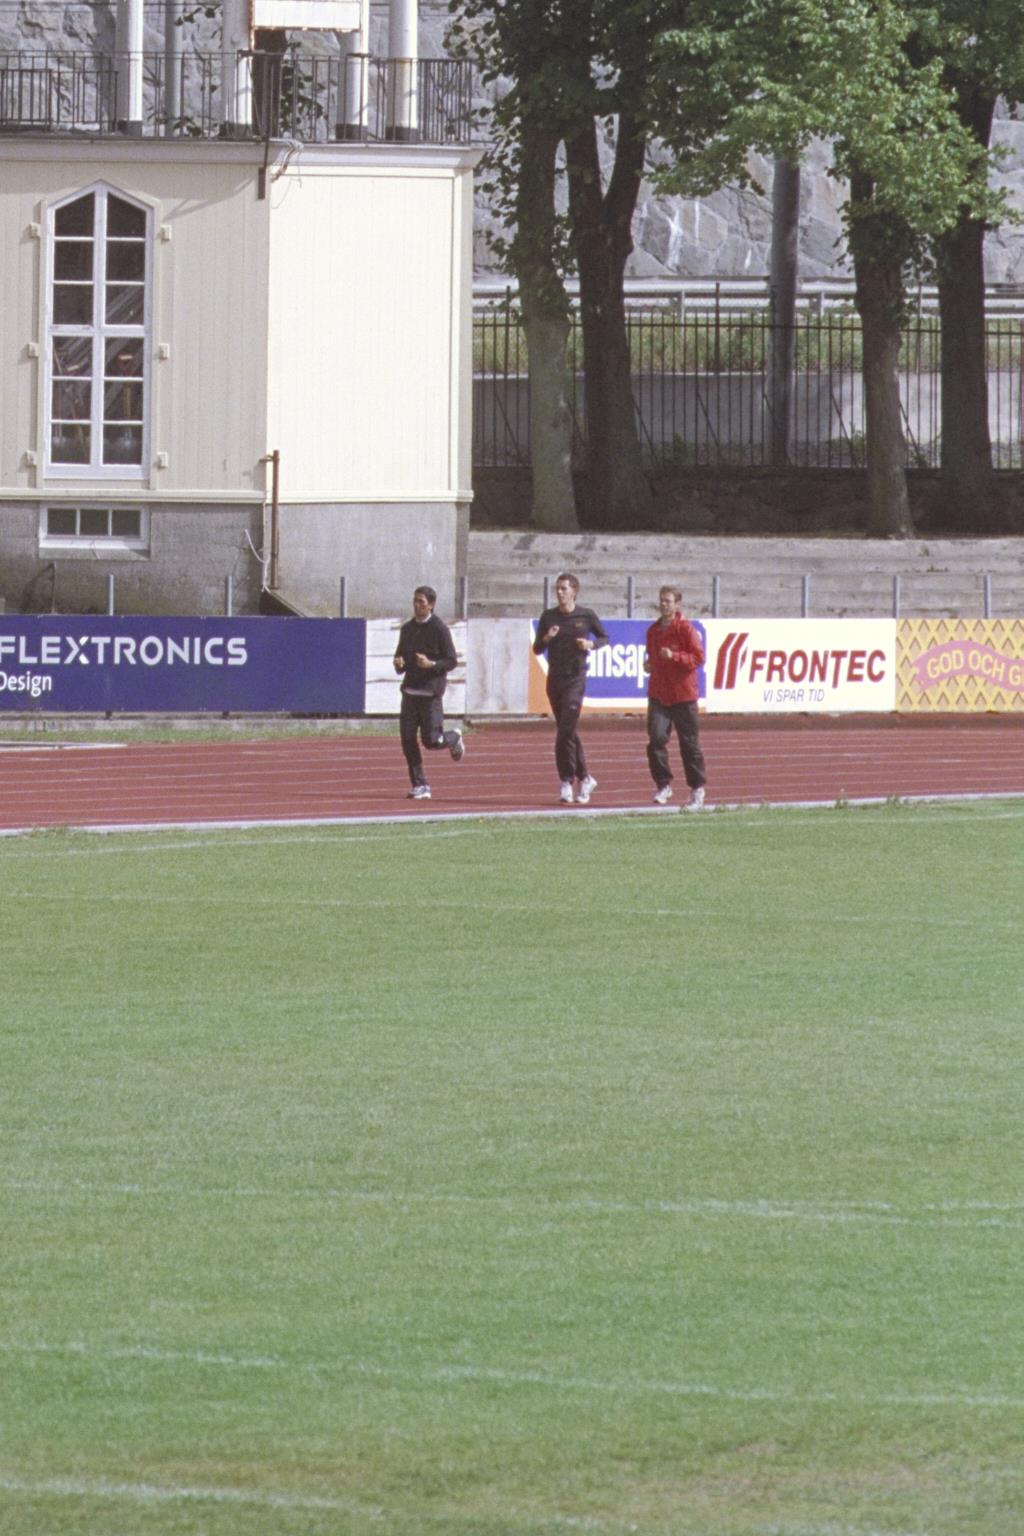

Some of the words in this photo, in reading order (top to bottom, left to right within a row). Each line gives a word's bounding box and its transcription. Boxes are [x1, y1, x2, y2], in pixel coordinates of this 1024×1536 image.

[748, 649, 887, 689] FRONTEC
[926, 648, 964, 679] GOD
[968, 649, 1006, 682] OCH
[763, 690, 774, 702] VI
[775, 689, 805, 702] SPAR
[808, 688, 825, 702] TID
